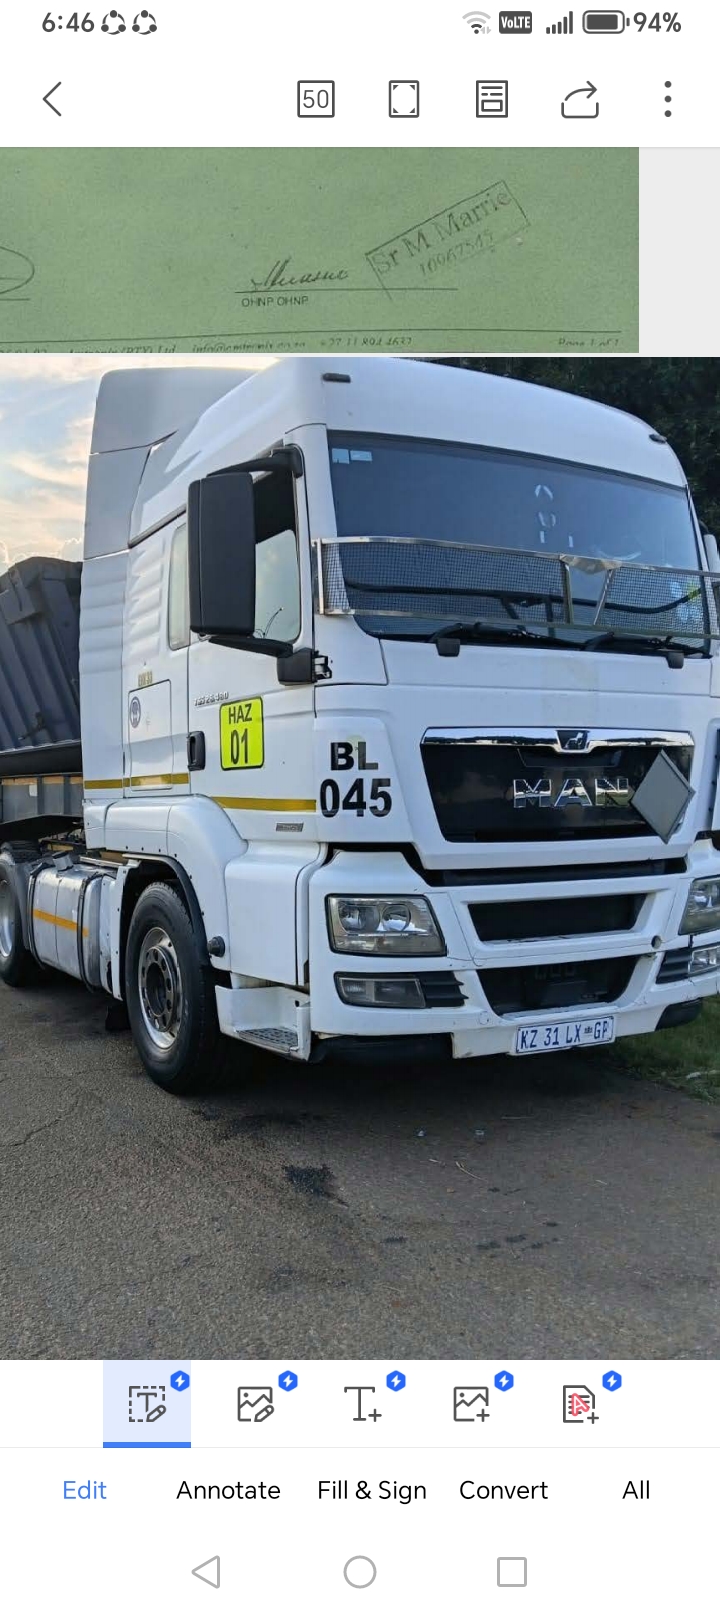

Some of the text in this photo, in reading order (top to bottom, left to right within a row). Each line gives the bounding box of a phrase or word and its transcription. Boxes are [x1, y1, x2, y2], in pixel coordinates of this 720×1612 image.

[42, 12, 94, 33] 6:46
[502, 16, 531, 29] VoLTE
[633, 12, 682, 33] 94%
[303, 89, 329, 110] 50
[372, 247, 400, 275] Sr
[401, 230, 431, 257] M
[432, 192, 513, 241] Marrie
[241, 296, 308, 308] OHNP OHNP
[228, 702, 252, 724] HAZ
[230, 728, 249, 764] 01
[330, 741, 379, 771] BL
[320, 778, 392, 819] 045
[513, 778, 629, 808] MAN
[520, 1020, 608, 1049] KZ 31 LX GP
[62, 1479, 107, 1500] Edit
[176, 1479, 281, 1500] Annotate
[318, 1479, 427, 1505] Fill & Sign
[459, 1480, 549, 1500] Convert
[622, 1479, 650, 1500] All
